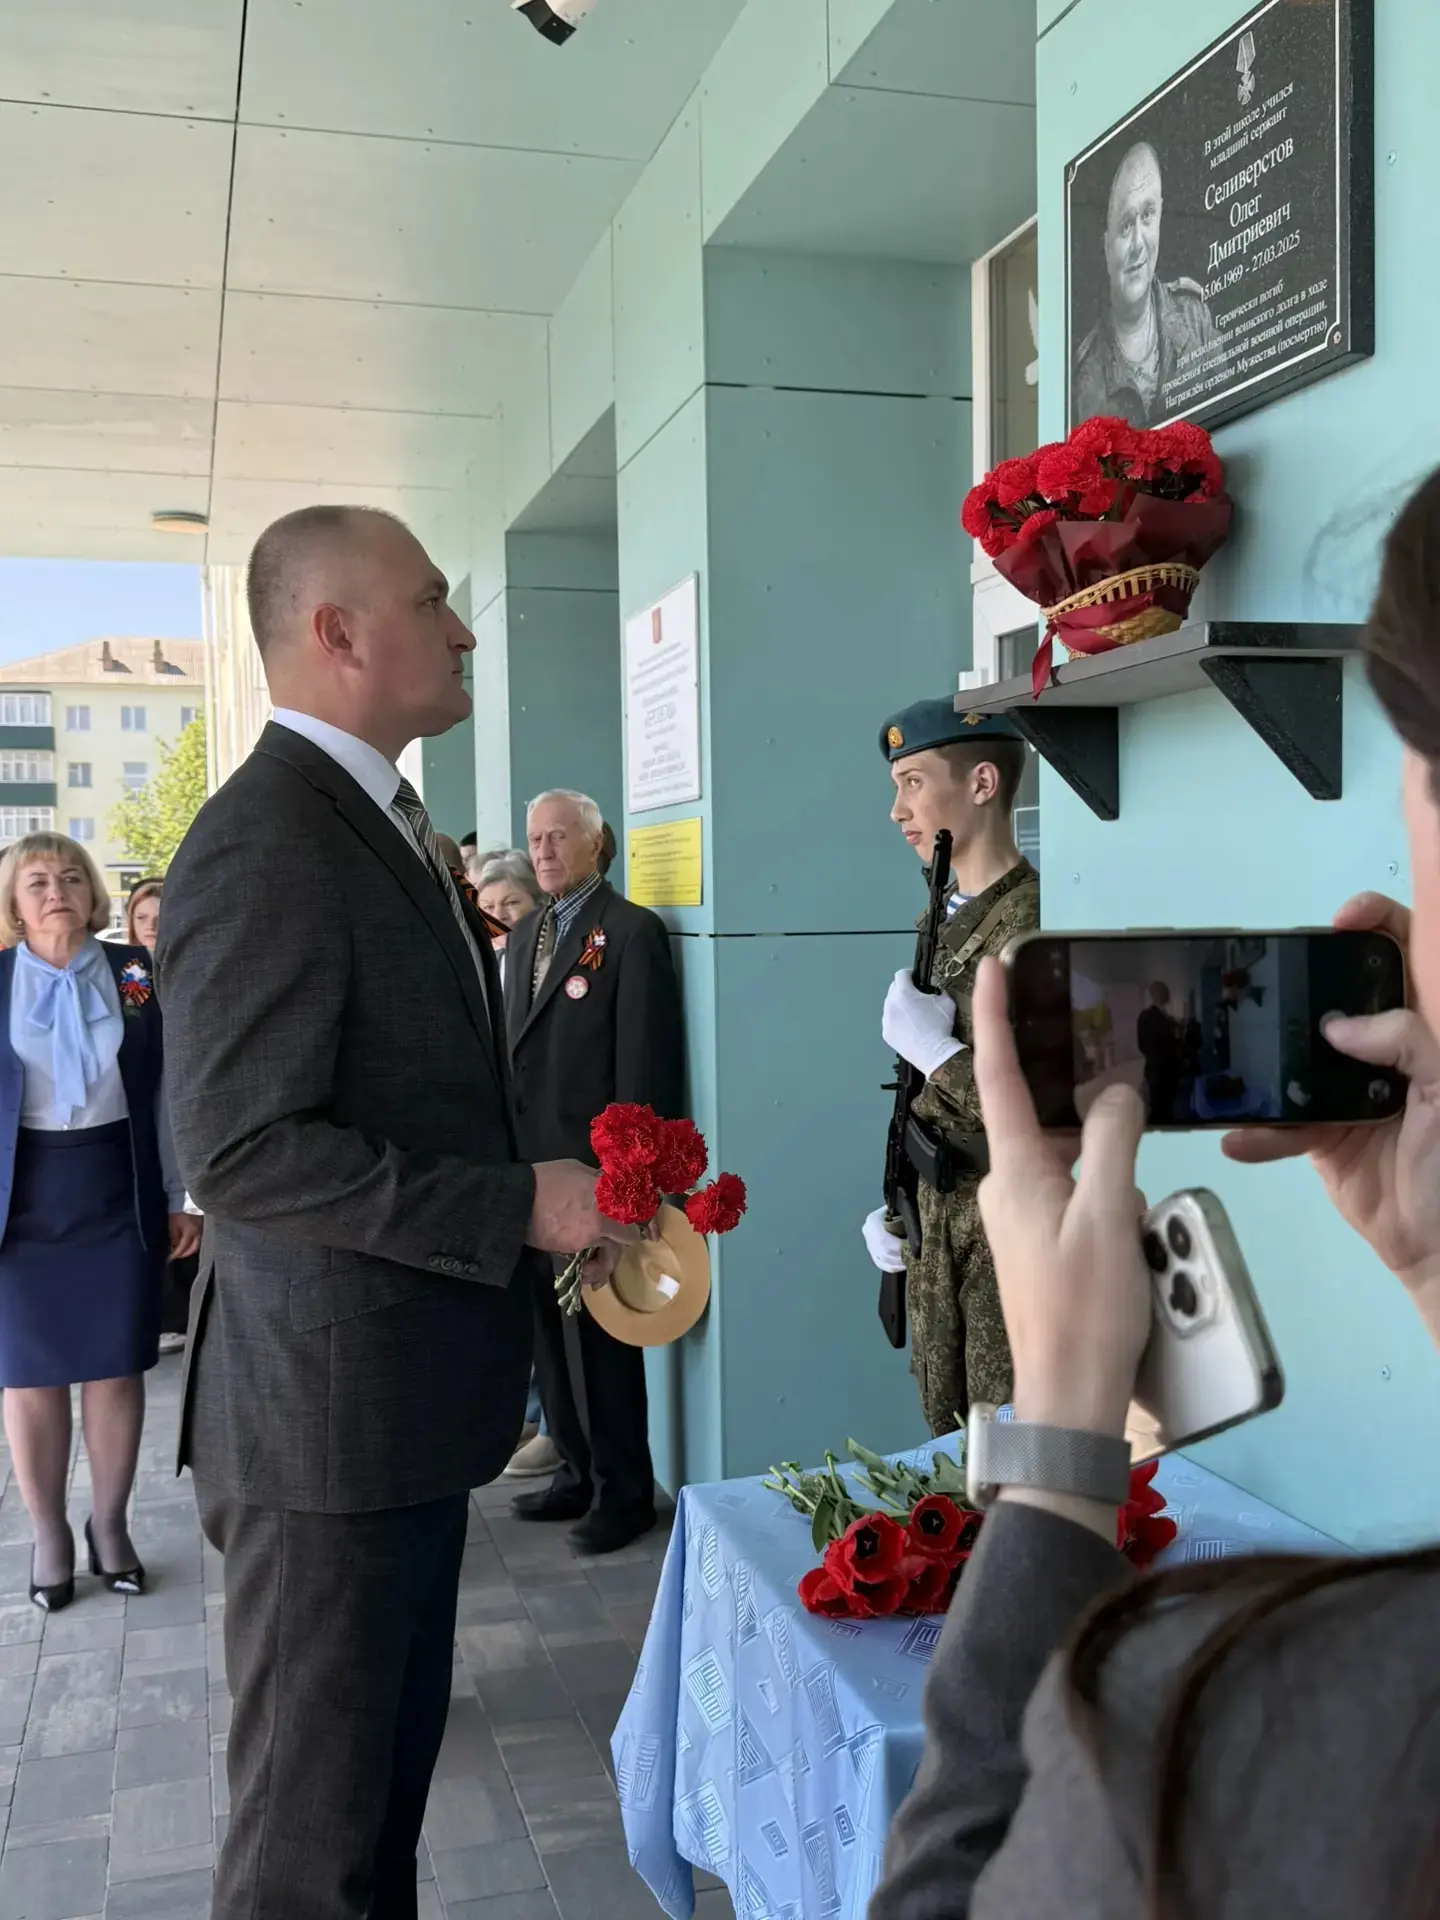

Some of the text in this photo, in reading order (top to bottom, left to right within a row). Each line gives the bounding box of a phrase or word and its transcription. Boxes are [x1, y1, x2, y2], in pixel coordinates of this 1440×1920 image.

[1205, 82, 1293, 156] В этой школе учился
[1210, 106, 1288, 170] младший сержант
[1204, 138, 1293, 210] Селиверстов
[1207, 201, 1291, 275] Дмитриевич
[1229, 193, 1262, 228] Олег
[1251, 229, 1300, 272] 27.03.2025
[1215, 279, 1284, 329] Героически погиб
[1235, 307, 1274, 336] воинского
[1275, 293, 1299, 316] долга
[1307, 278, 1328, 298] ходе
[1236, 345, 1277, 373] Мужества
[1277, 316, 1328, 354] (посмертно)
[1250, 319, 1283, 347] военной
